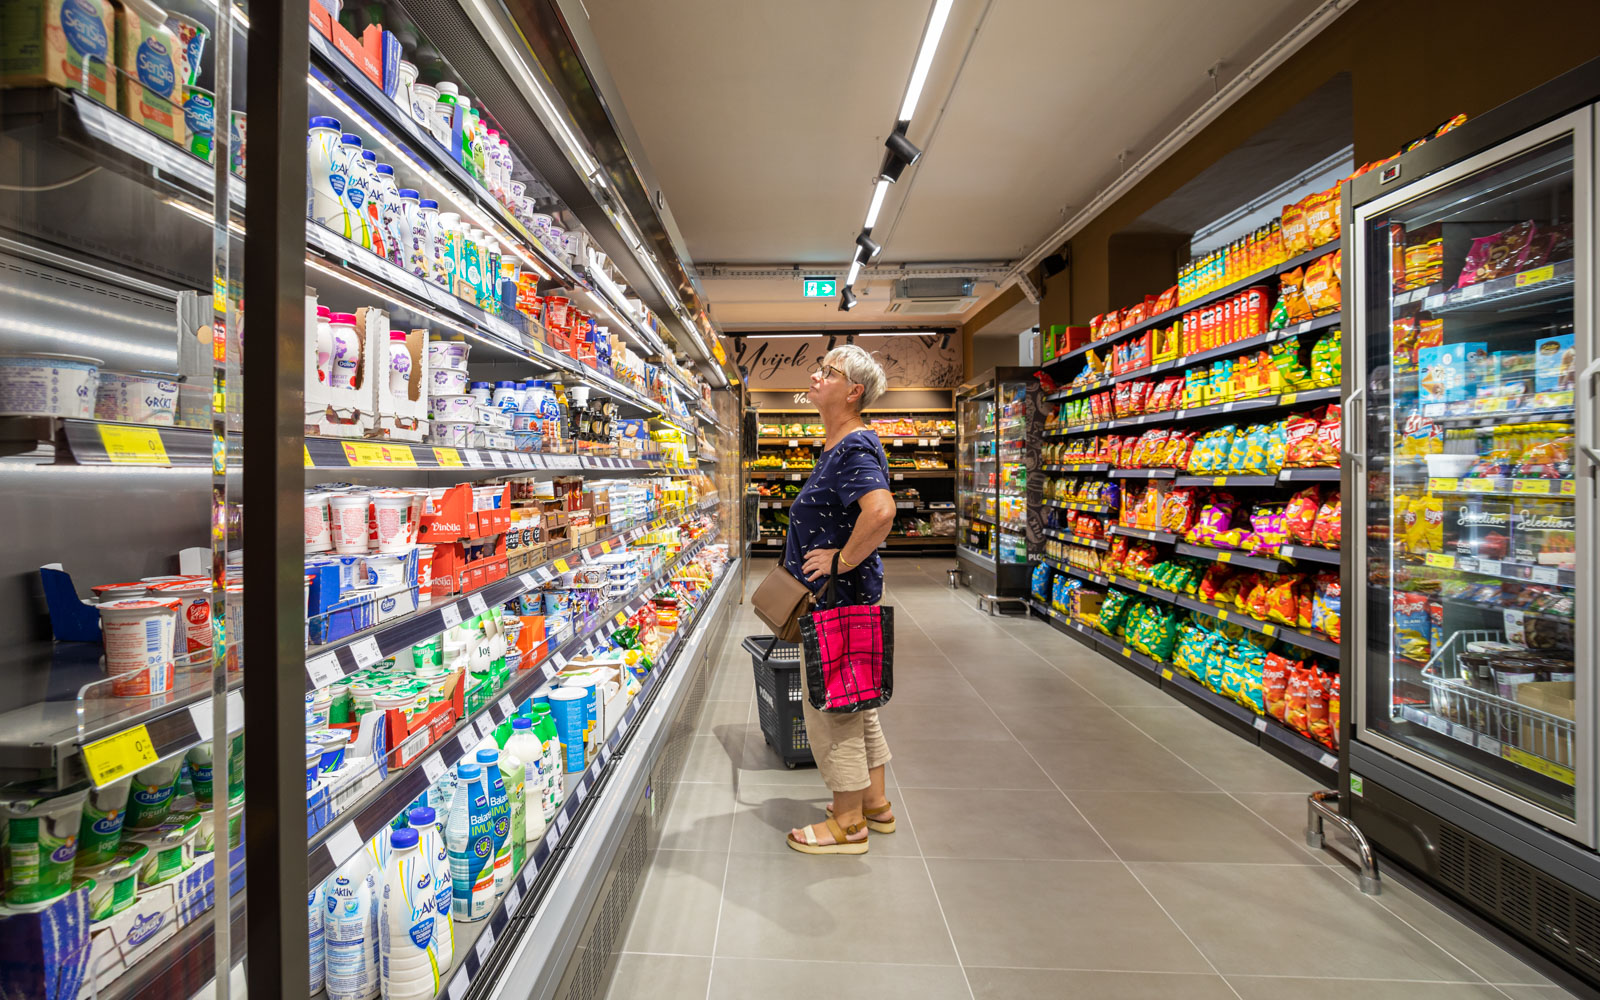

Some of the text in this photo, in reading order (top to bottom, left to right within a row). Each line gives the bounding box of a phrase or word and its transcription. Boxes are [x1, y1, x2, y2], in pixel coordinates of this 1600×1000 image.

[1516, 509, 1575, 531] Selection
[431, 522, 461, 532] Vindija
[141, 788, 170, 800] Dukat
